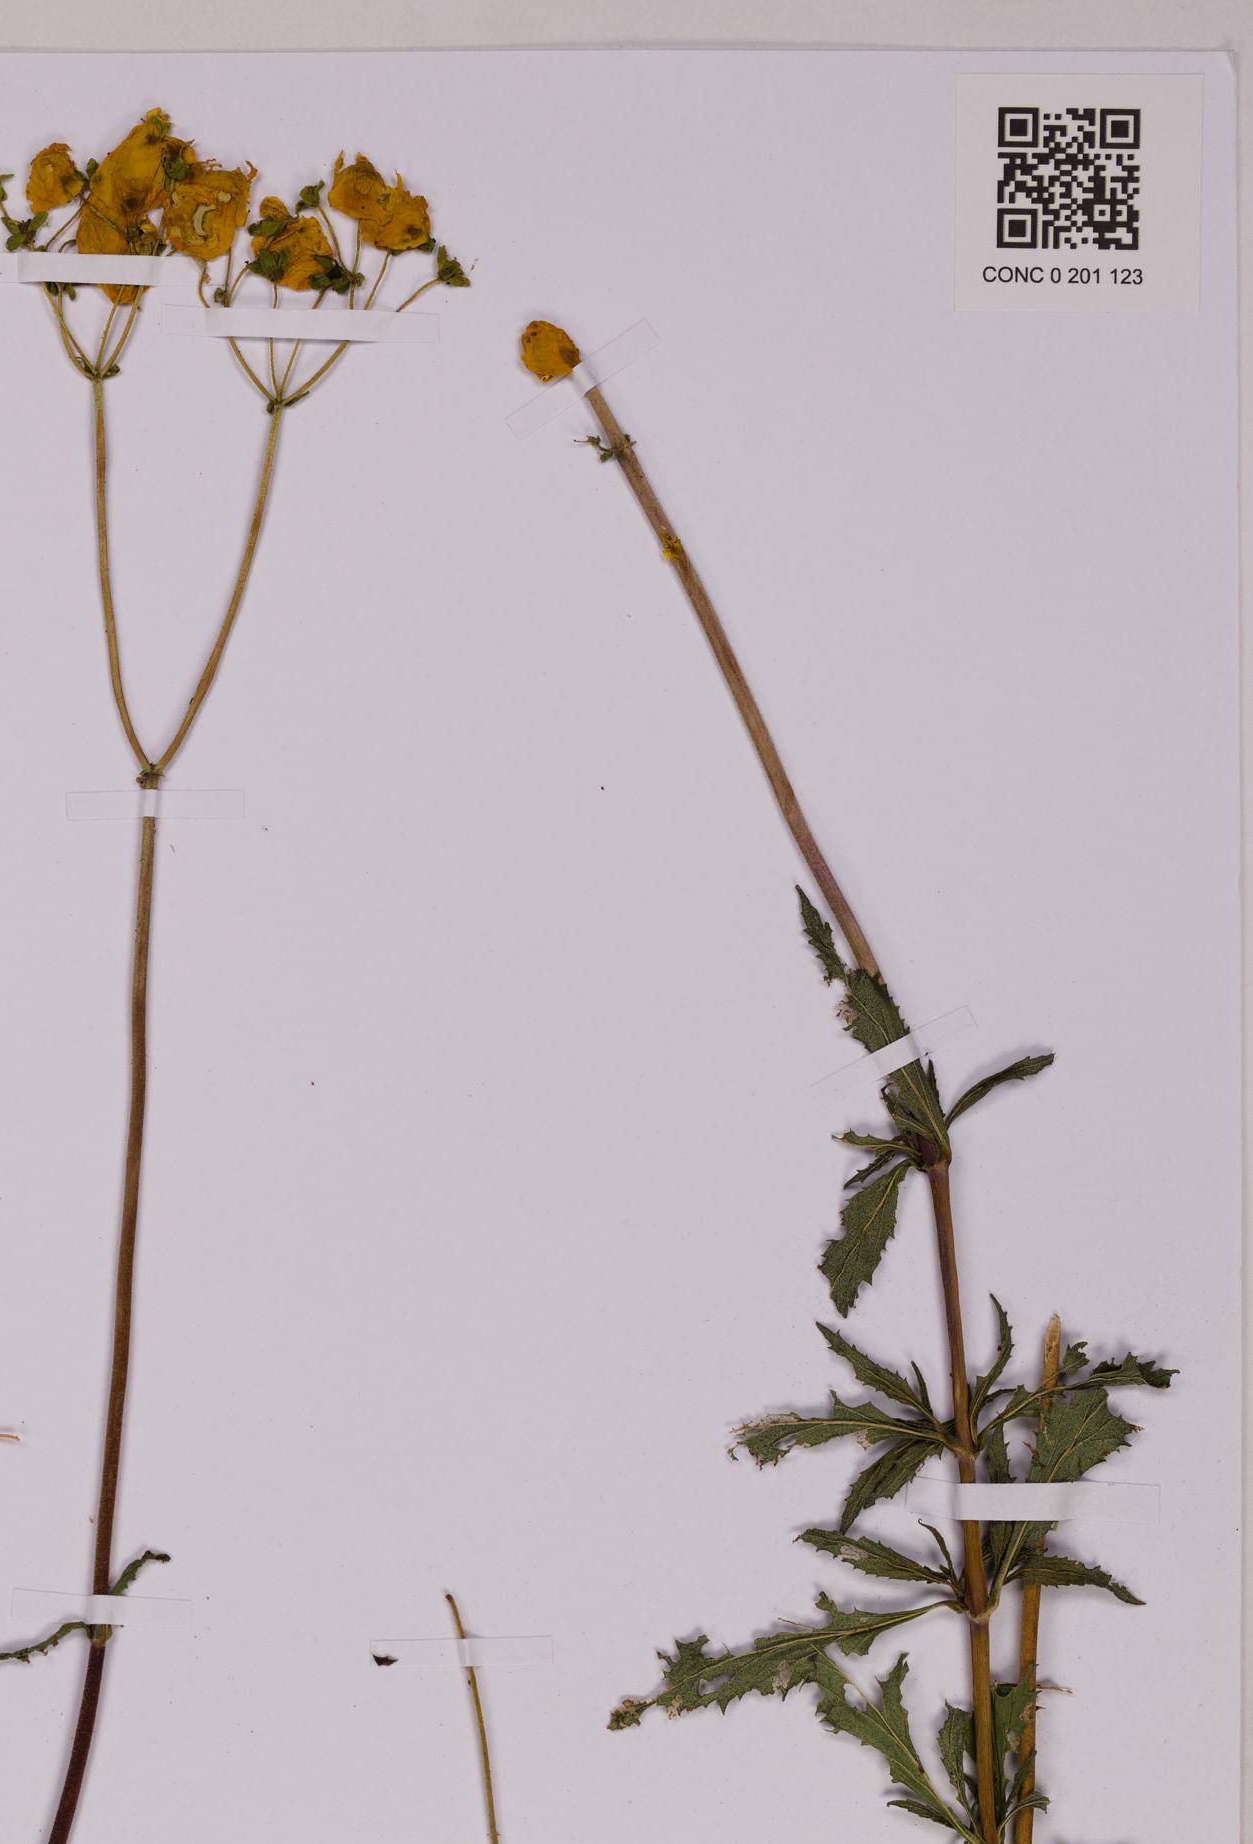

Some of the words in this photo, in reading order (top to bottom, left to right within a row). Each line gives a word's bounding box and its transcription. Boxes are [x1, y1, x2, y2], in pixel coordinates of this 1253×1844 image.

[982, 265, 1044, 284] CONC
[1050, 267, 1062, 284] 0
[1067, 267, 1101, 285] 201
[1110, 268, 1144, 285] 123
